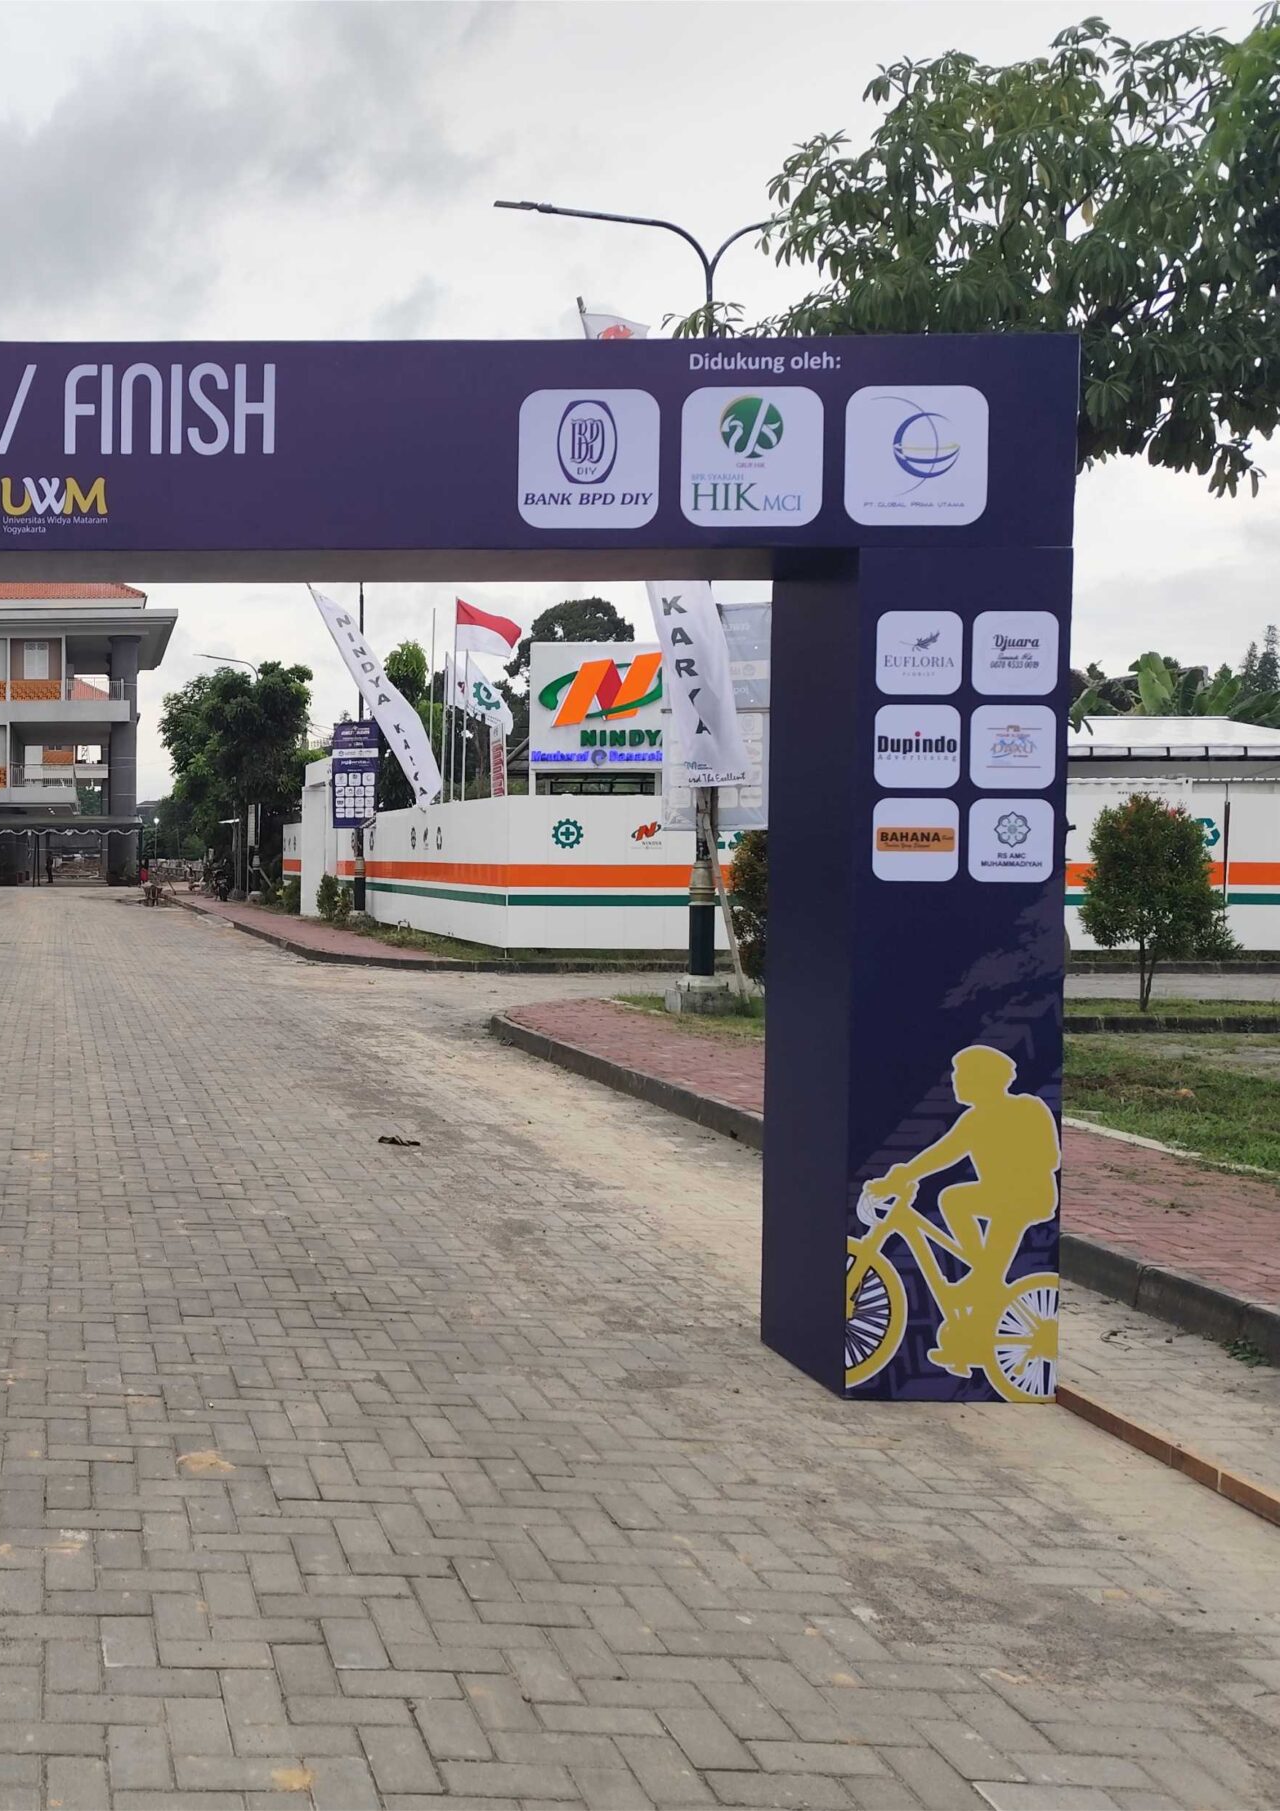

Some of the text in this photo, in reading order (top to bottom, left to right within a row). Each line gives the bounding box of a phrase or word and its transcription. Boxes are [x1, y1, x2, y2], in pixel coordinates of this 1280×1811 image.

[689, 351, 841, 373] Didukung oleh:
[64, 362, 276, 455] FINISH
[577, 467, 597, 475] DIY
[1, 477, 108, 515] UWM
[524, 492, 653, 506] BANK BPD DIY
[691, 482, 802, 511] HIK MCI
[2, 516, 108, 525] Universitas Widya Mataram
[2, 526, 46, 534] Yogyakarta
[992, 634, 1040, 651] Djuara
[336, 614, 391, 706] NINDYA
[884, 654, 954, 668] EUFLORIA
[877, 731, 957, 754] Dupindo
[877, 754, 957, 762] Advertising
[880, 831, 941, 842] BAHANA
